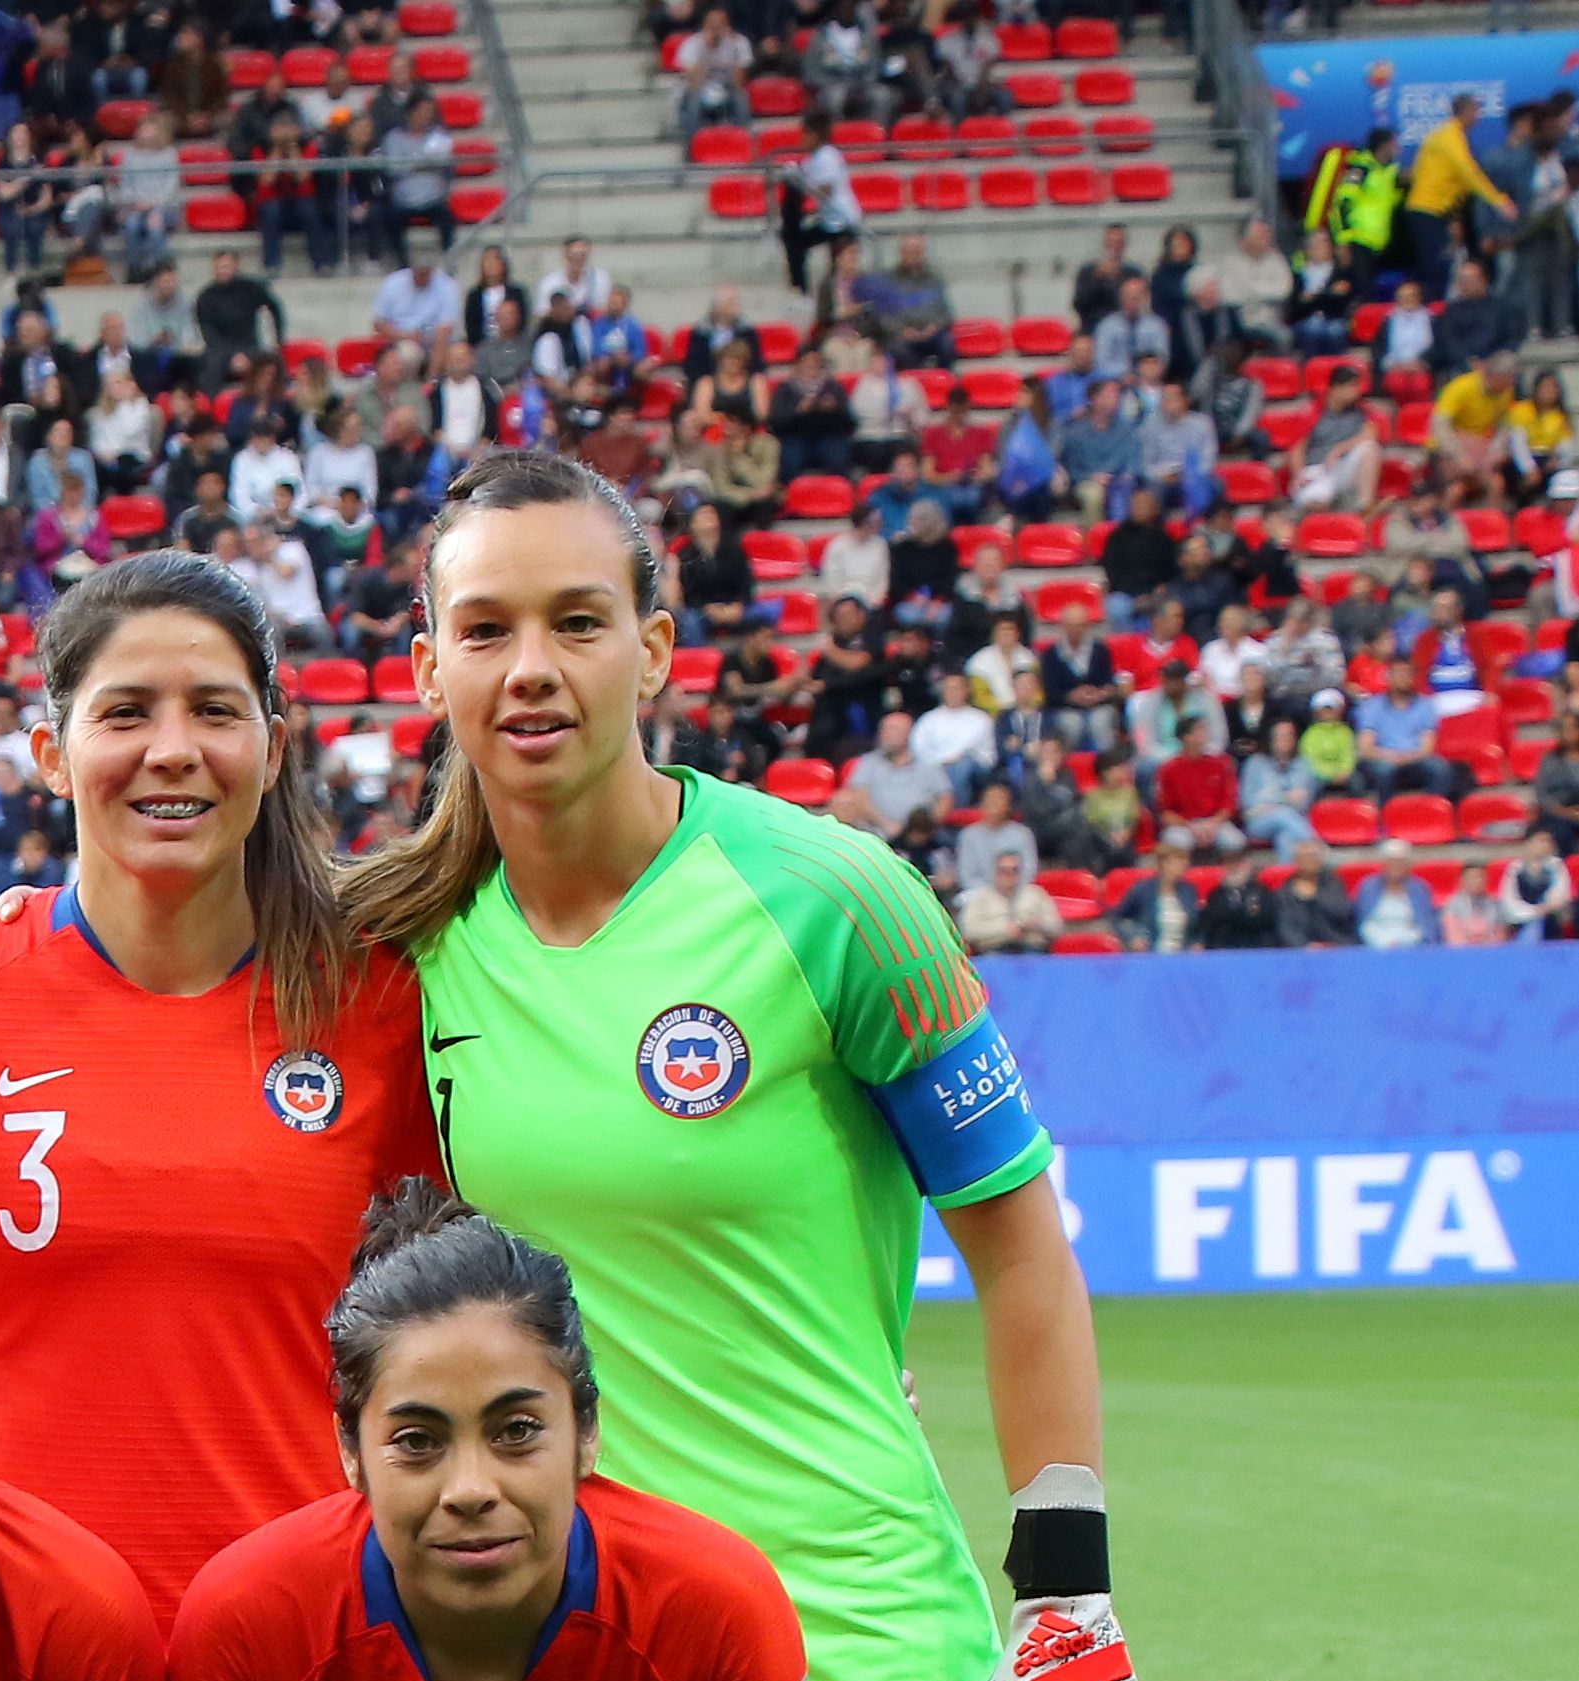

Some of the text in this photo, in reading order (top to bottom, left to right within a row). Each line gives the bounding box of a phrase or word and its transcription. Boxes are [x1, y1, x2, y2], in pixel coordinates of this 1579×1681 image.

[640, 1008, 746, 1064] FEDERACION DE FUTBOL
[663, 1095, 722, 1114] DE CHILE
[1153, 1151, 1518, 1281] FIFA
[1014, 1632, 1095, 1677] adidas
